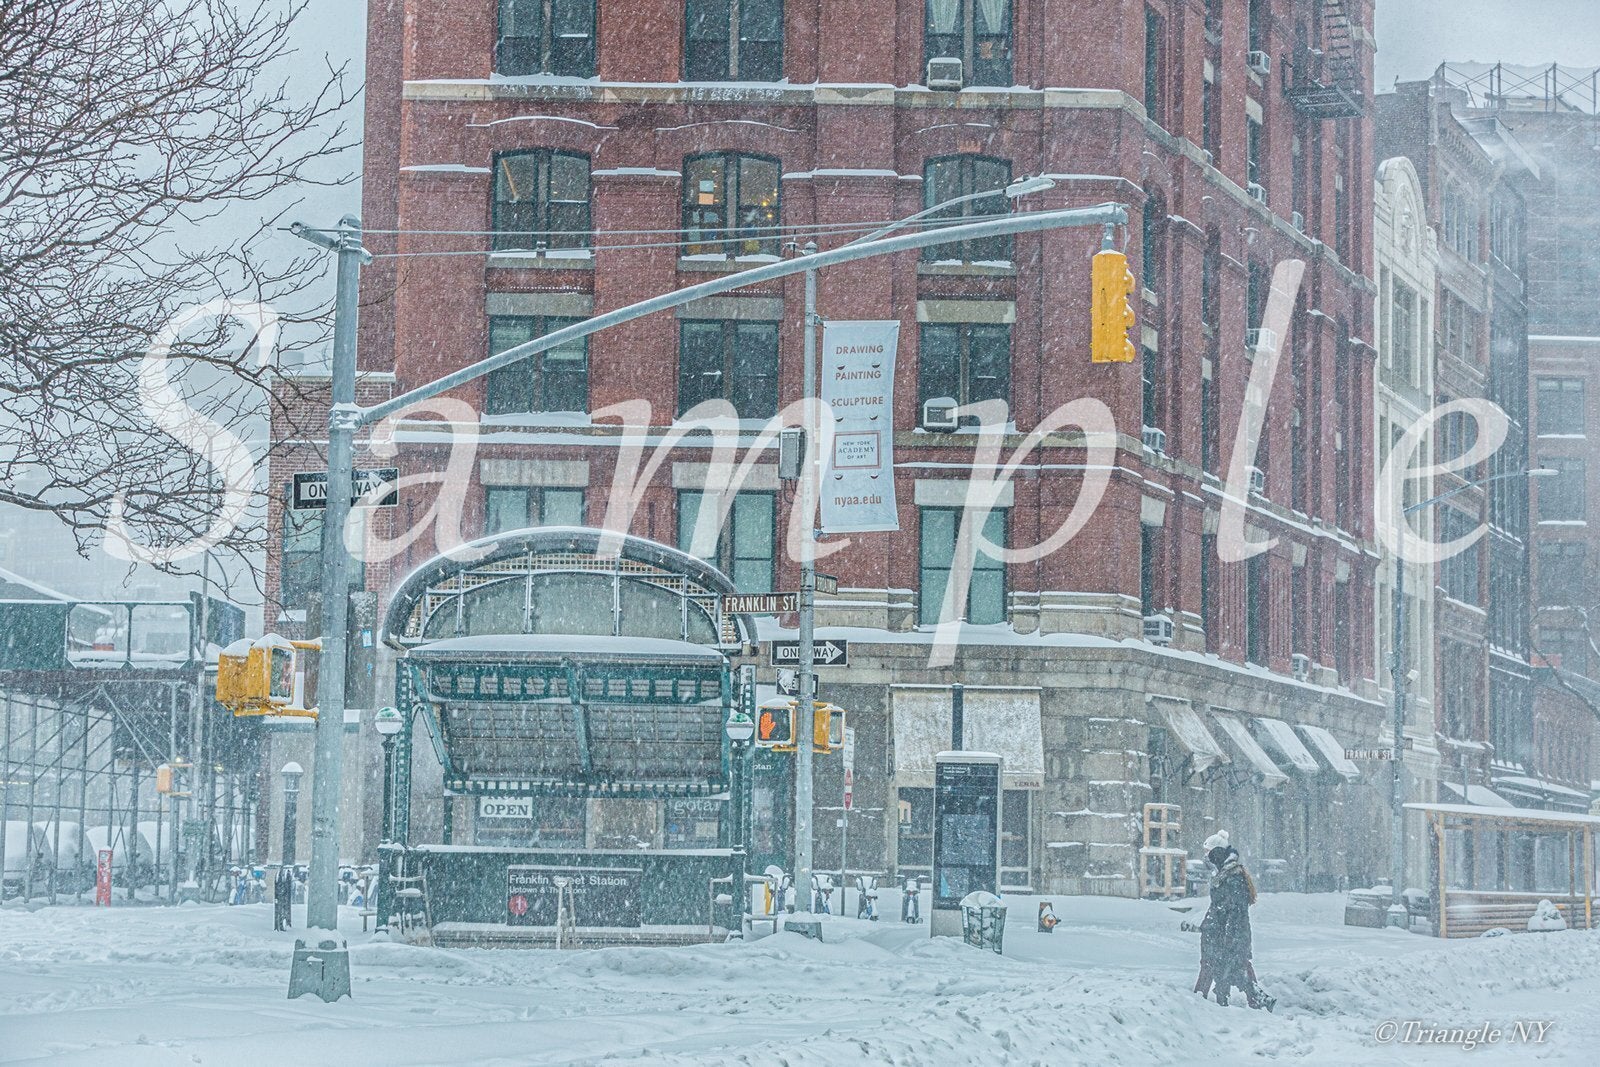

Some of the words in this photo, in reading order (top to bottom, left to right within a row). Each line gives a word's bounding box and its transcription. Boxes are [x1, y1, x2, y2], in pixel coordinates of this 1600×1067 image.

[835, 345, 884, 355] DRAWING
[835, 370, 882, 381] PAINTING
[831, 396, 884, 407] SCULPTURE
[838, 446, 875, 454] ACADEMY
[308, 483, 328, 498] ON
[834, 494, 882, 508] nyaa.edu
[724, 596, 777, 612] FRANKLIN
[782, 595, 795, 611] ST
[782, 647, 800, 658] ON
[813, 647, 836, 658] WAY
[1345, 750, 1379, 760] FRANKLIN
[483, 803, 529, 816] OPEN
[509, 874, 549, 885] Franklin
[589, 875, 627, 886] Station
